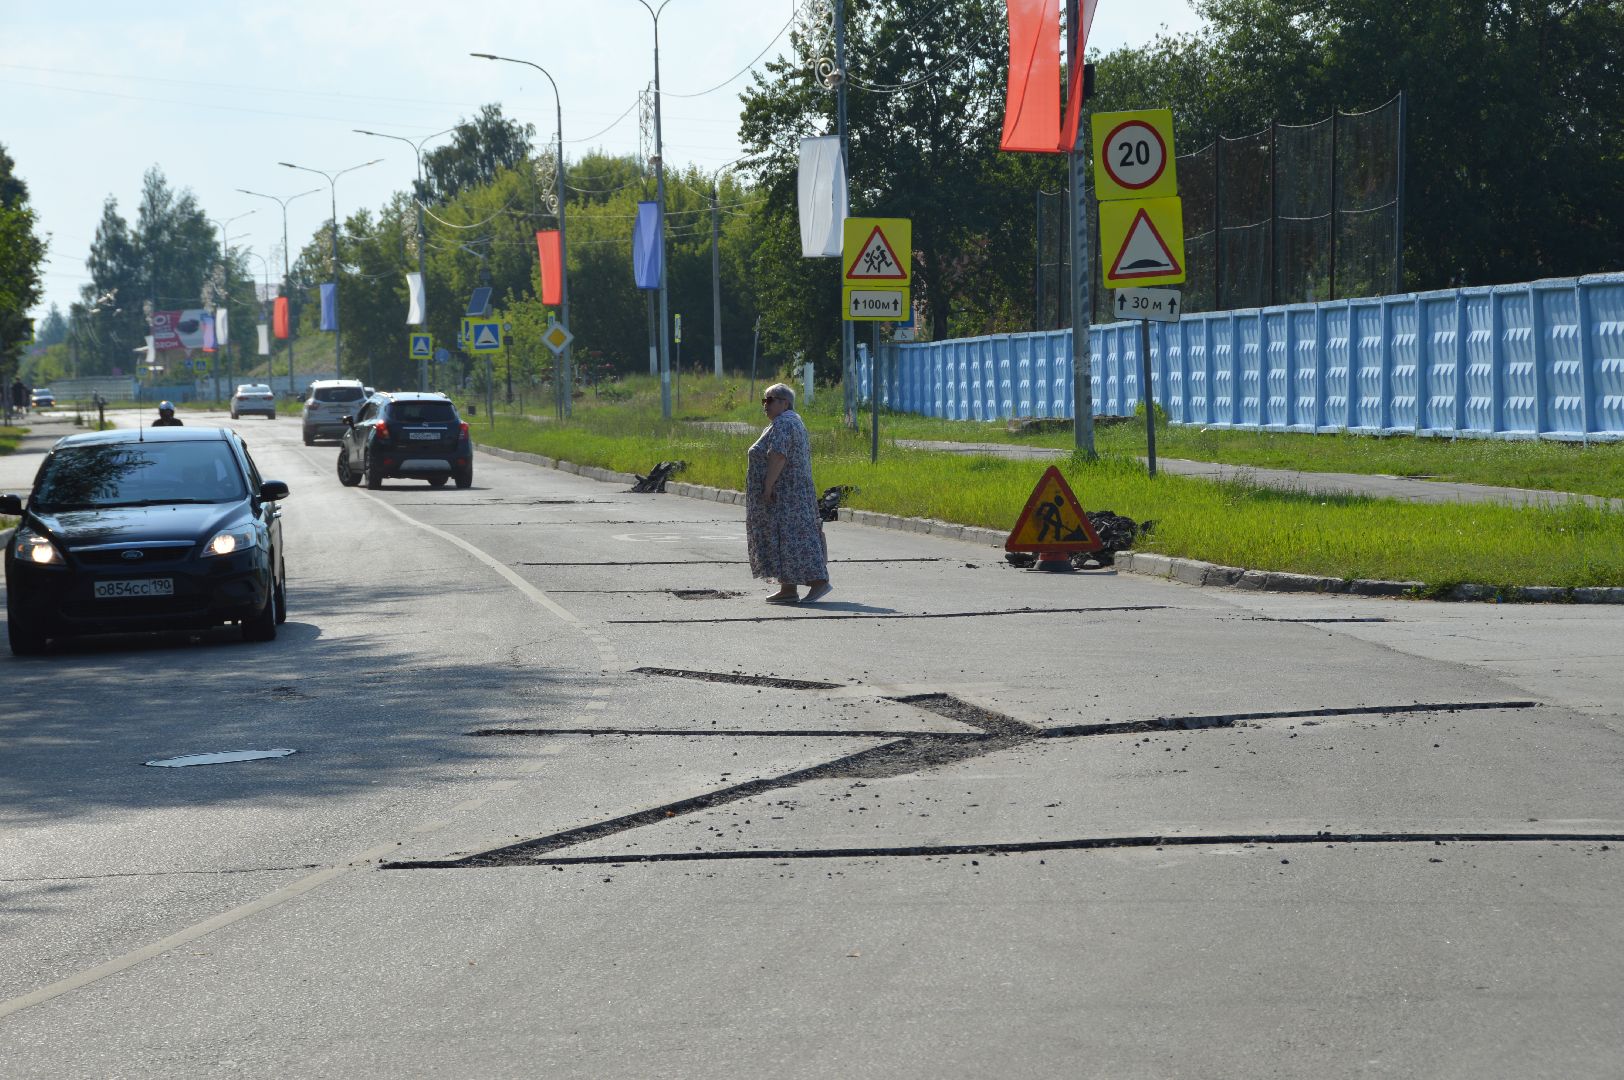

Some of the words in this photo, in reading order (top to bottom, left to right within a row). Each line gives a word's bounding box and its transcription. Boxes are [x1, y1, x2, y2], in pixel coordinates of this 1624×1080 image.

[1118, 139, 1150, 167] 20
[1131, 296, 1149, 309] 30
[151, 579, 171, 590] 190
